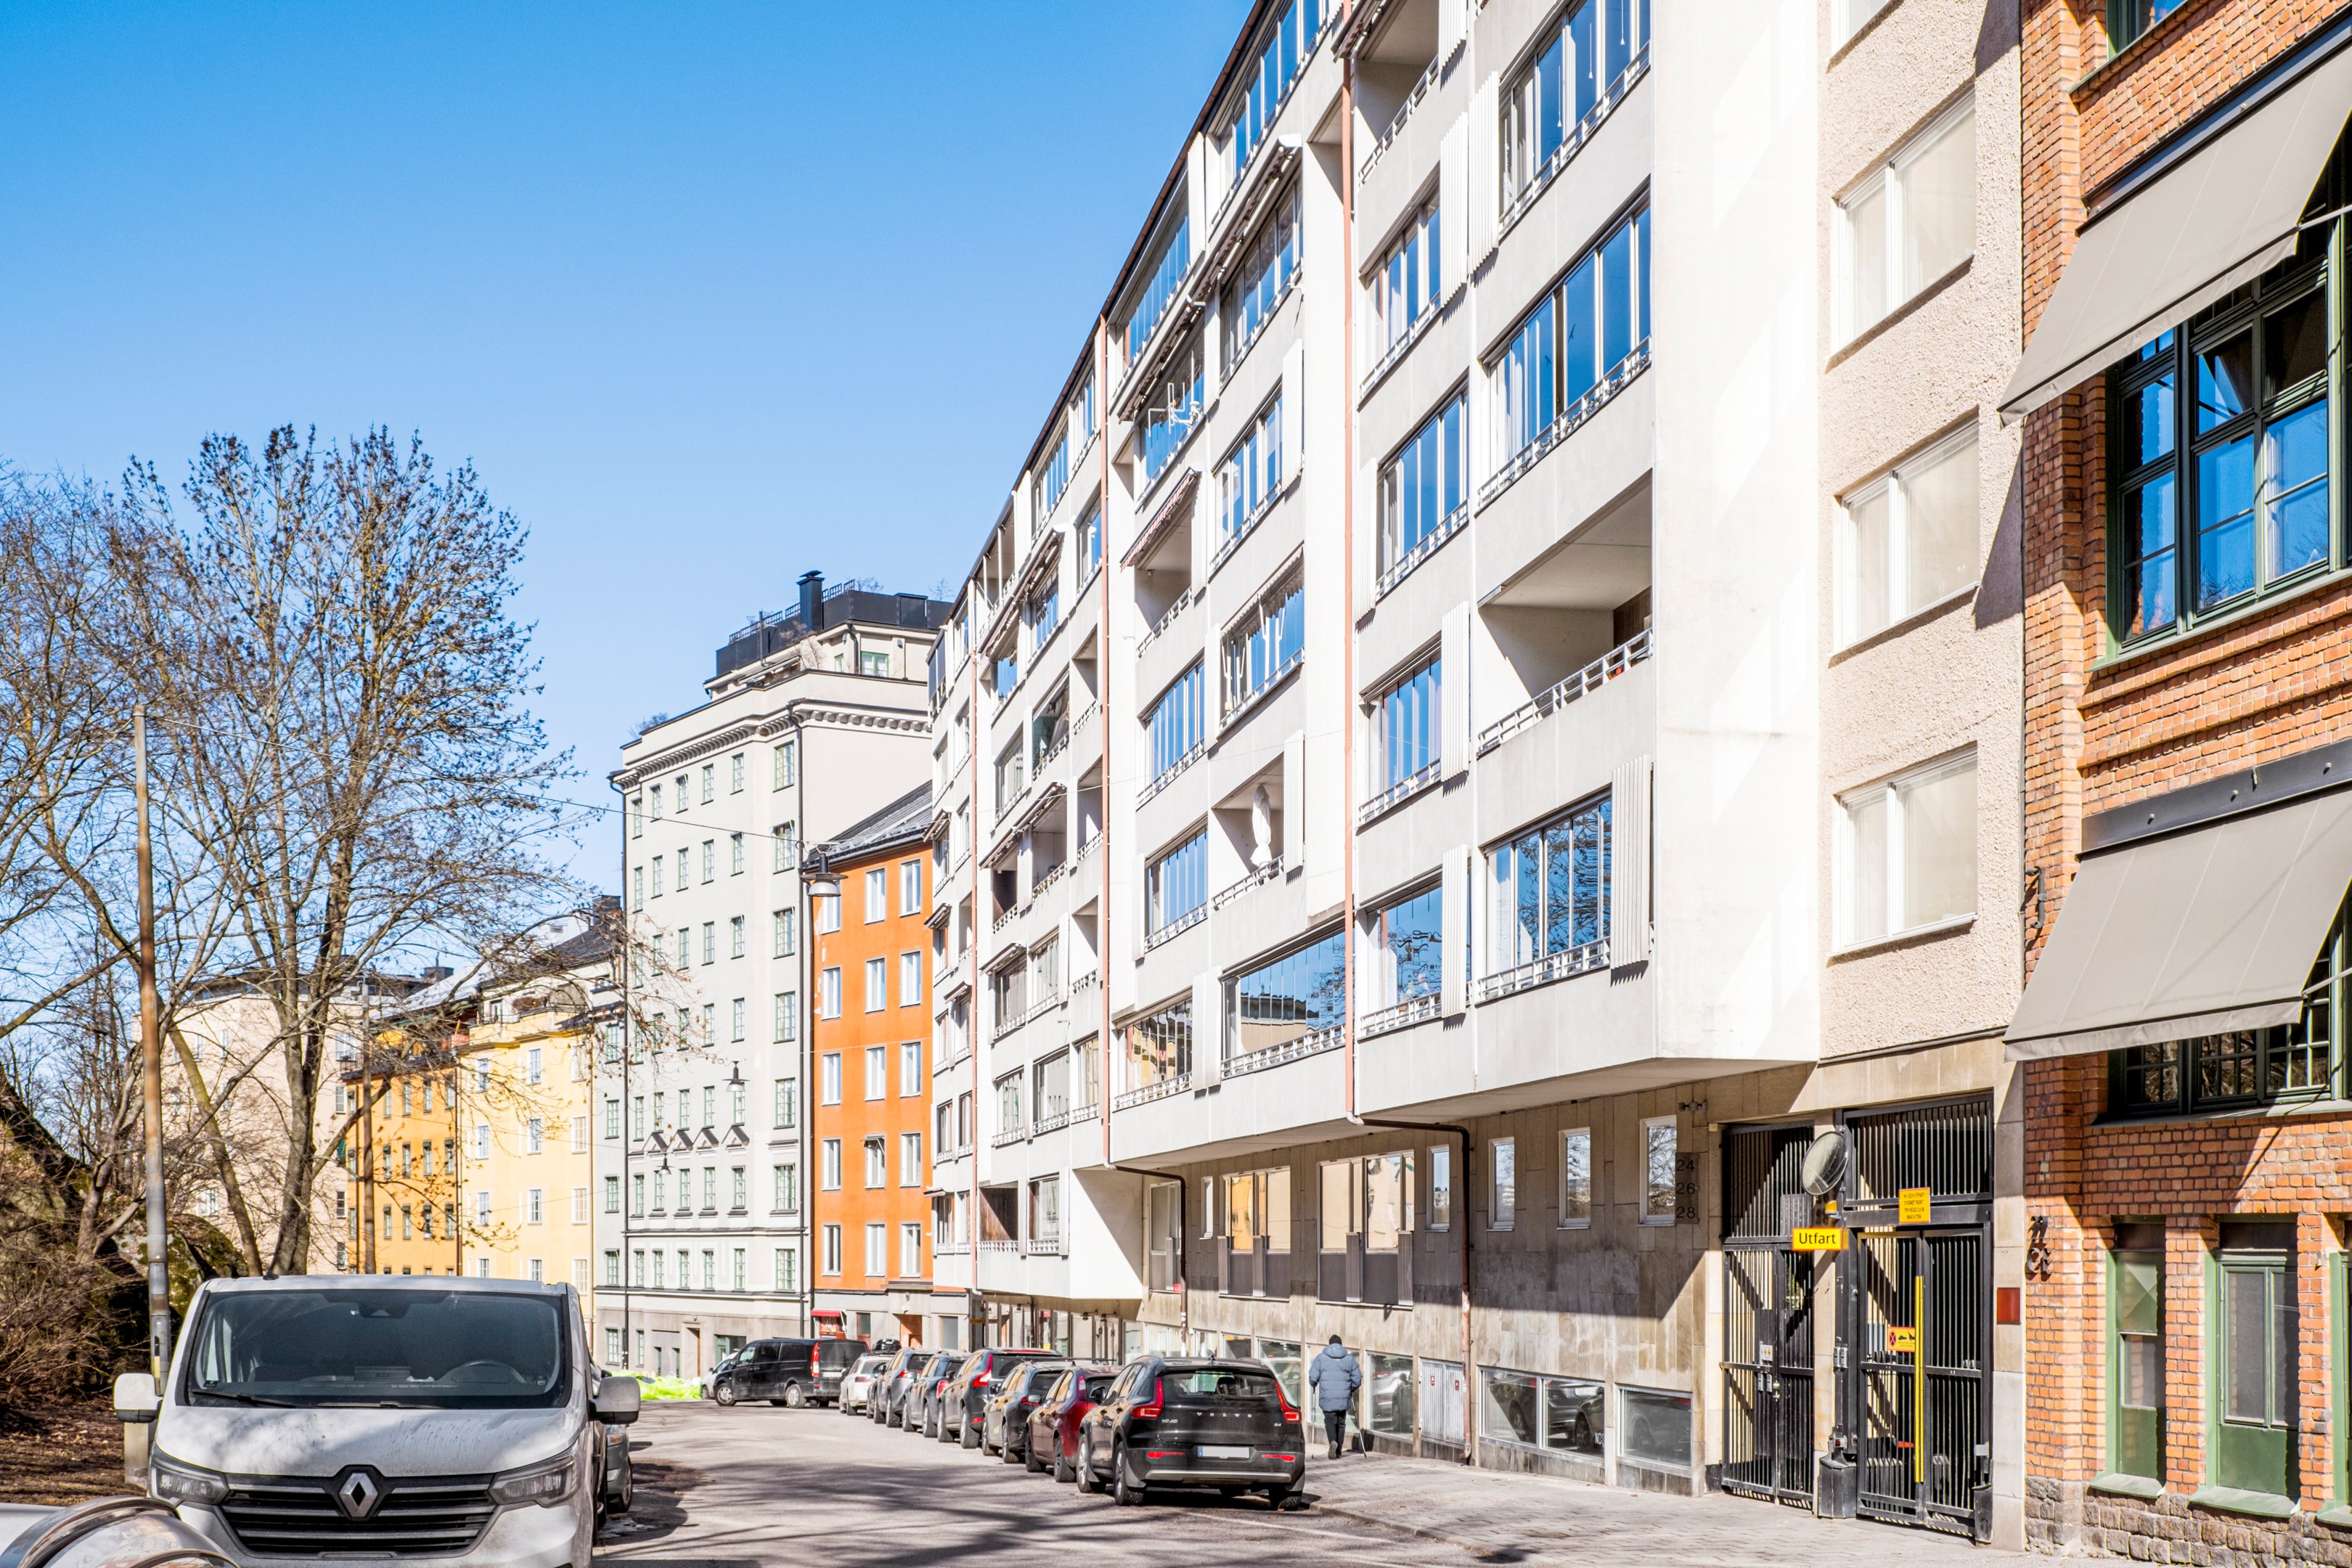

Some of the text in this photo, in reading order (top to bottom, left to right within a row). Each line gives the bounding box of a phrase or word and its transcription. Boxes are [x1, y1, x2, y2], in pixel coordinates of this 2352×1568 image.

[1676, 1159, 1695, 1172] 24
[1676, 1182, 1696, 1195] 26
[1676, 1206, 1696, 1219] 28
[1799, 1232, 1836, 1244] Utfart
